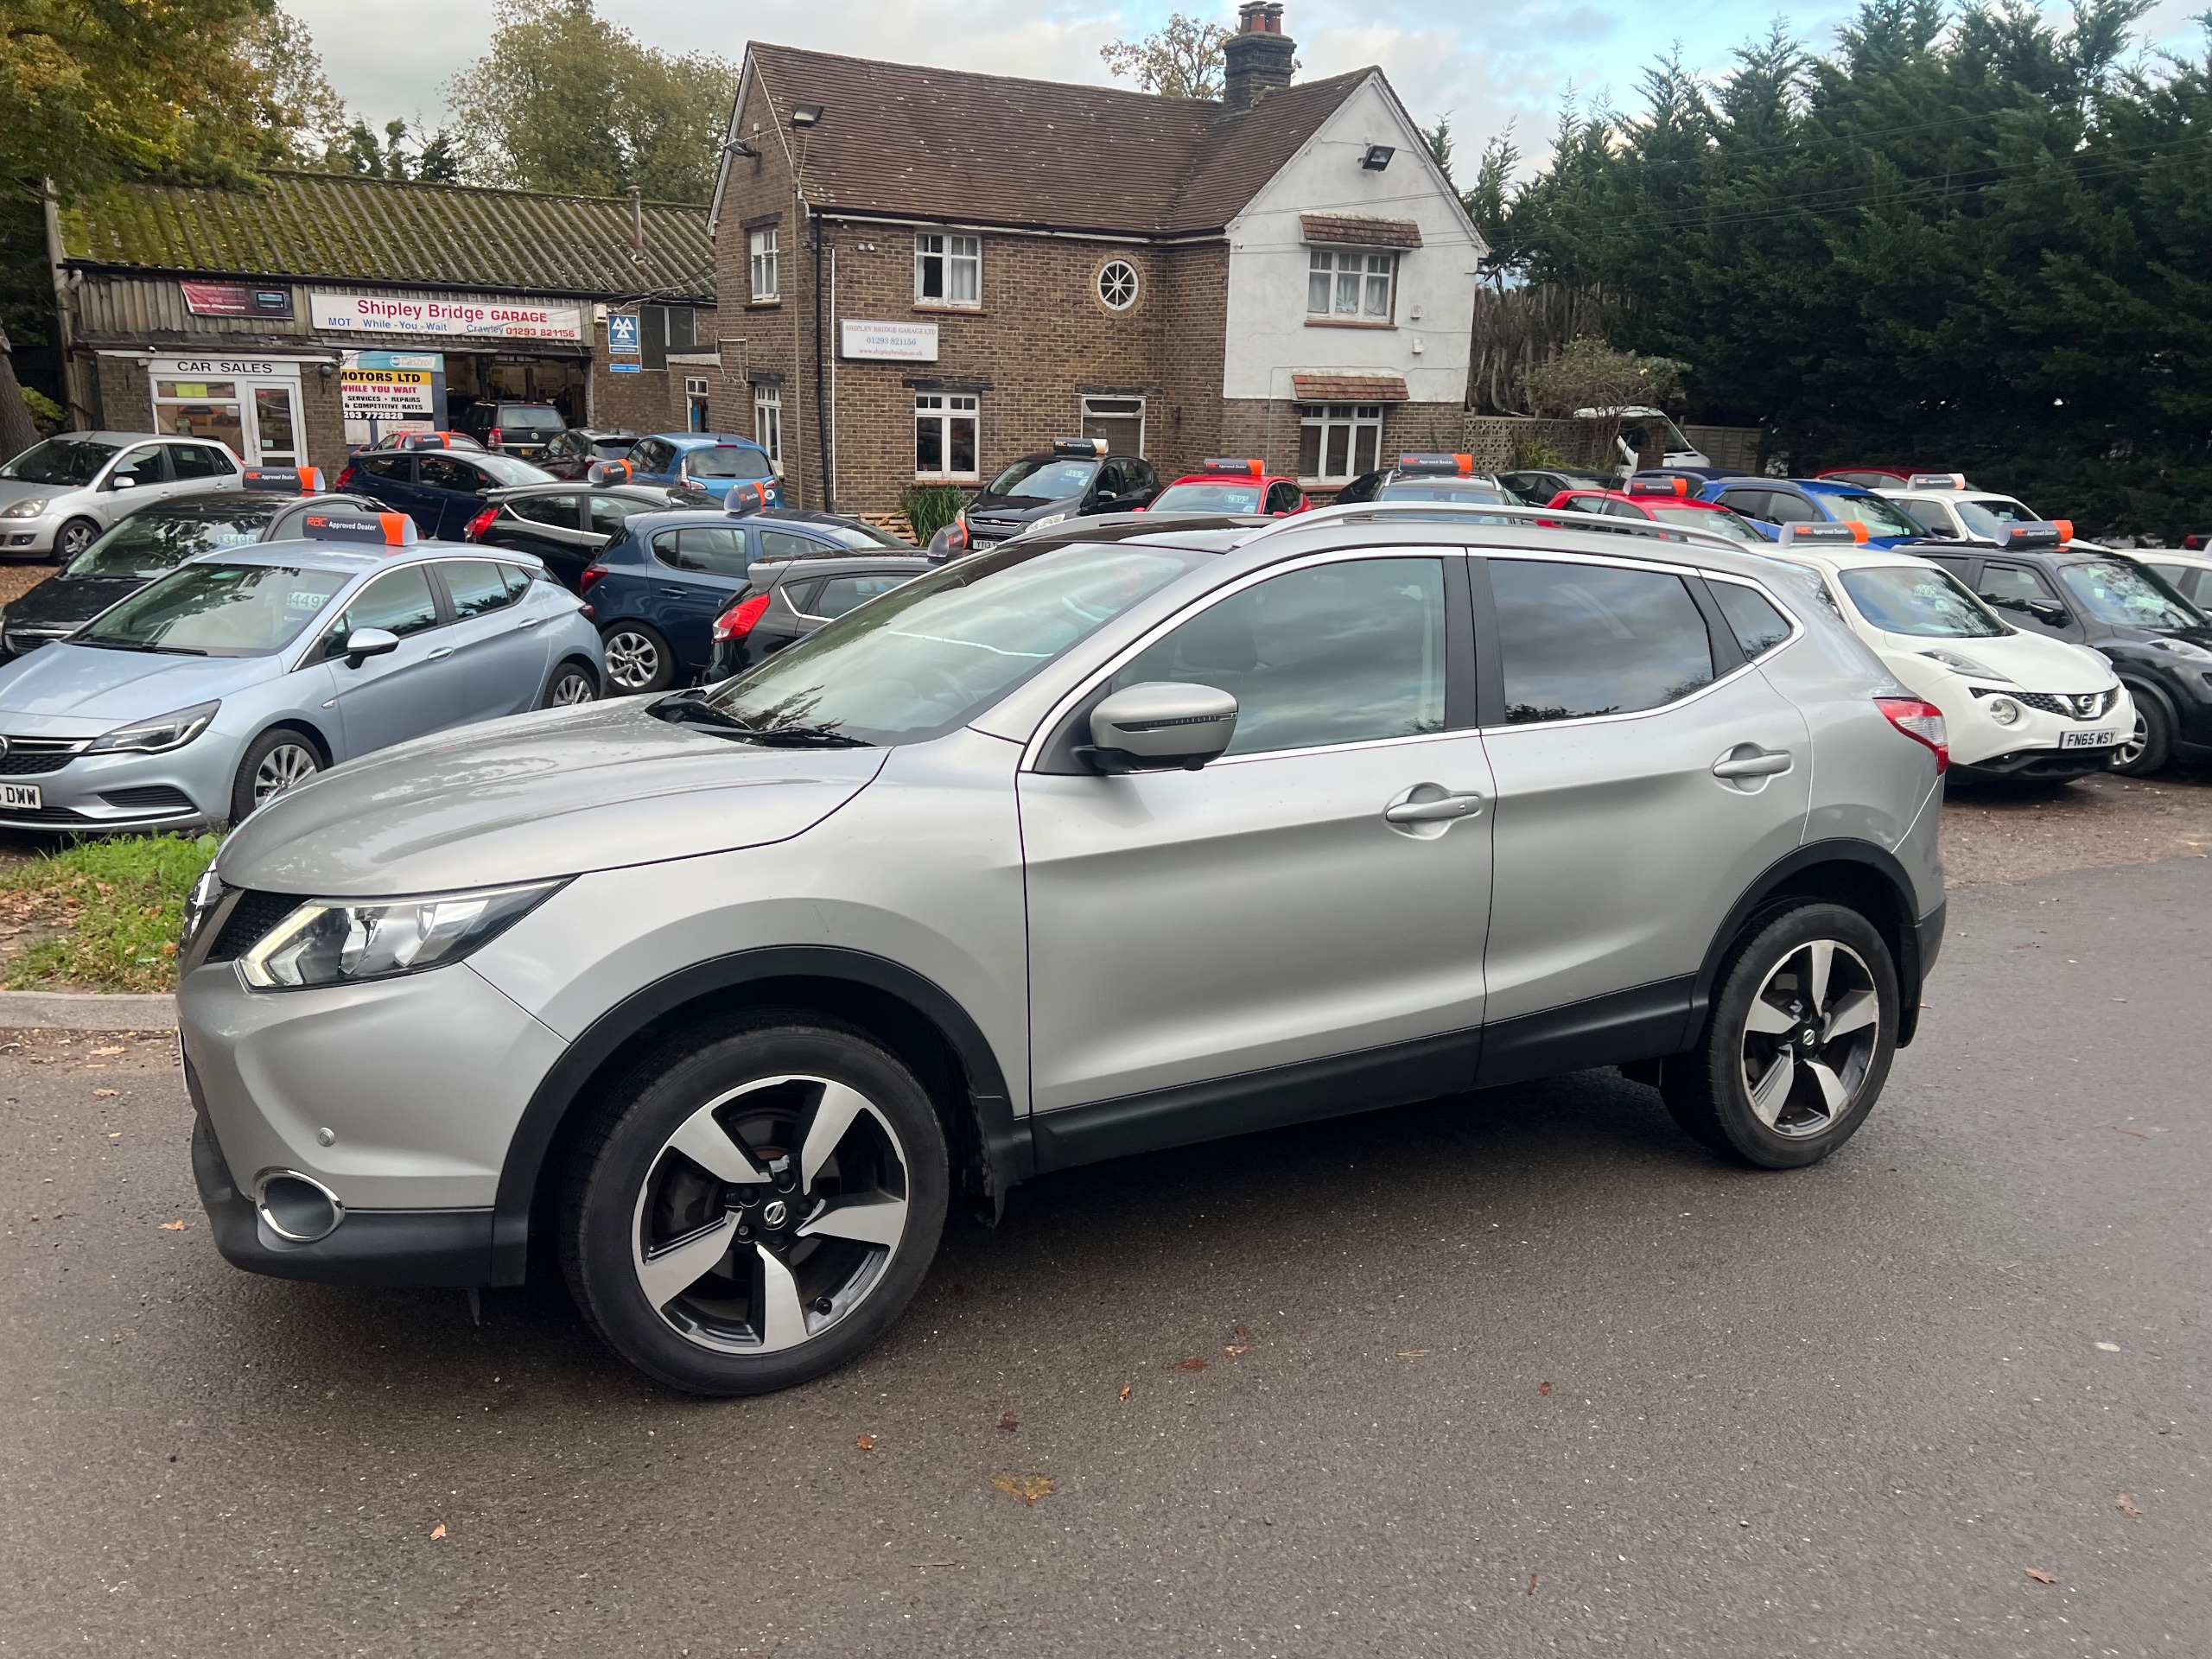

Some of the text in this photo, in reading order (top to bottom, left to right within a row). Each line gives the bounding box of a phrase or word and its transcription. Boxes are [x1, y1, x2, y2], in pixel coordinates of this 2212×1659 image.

[358, 299, 548, 323] Shipley Bridge GARAGE
[328, 317, 352, 327] MOT
[363, 319, 391, 329] While
[399, 321, 418, 330] You
[426, 321, 448, 332] Wait
[467, 324, 504, 335] Crawley
[506, 327, 537, 336] 01293
[540, 328, 575, 338] 821156
[845, 324, 873, 333] SHIPLEY
[890, 337, 917, 346] 821156
[859, 348, 923, 357] www.shipleybridge.co.uk
[177, 361, 273, 373] CAR SALES
[401, 357, 433, 367] Castrol
[340, 372, 421, 383] MOTORS LTD
[341, 385, 368, 393] WHILE
[328, 521, 356, 530] Approved
[356, 522, 377, 531] Dealer
[2067, 731, 2116, 747] FN65 WSY
[5, 786, 36, 805] DWW
